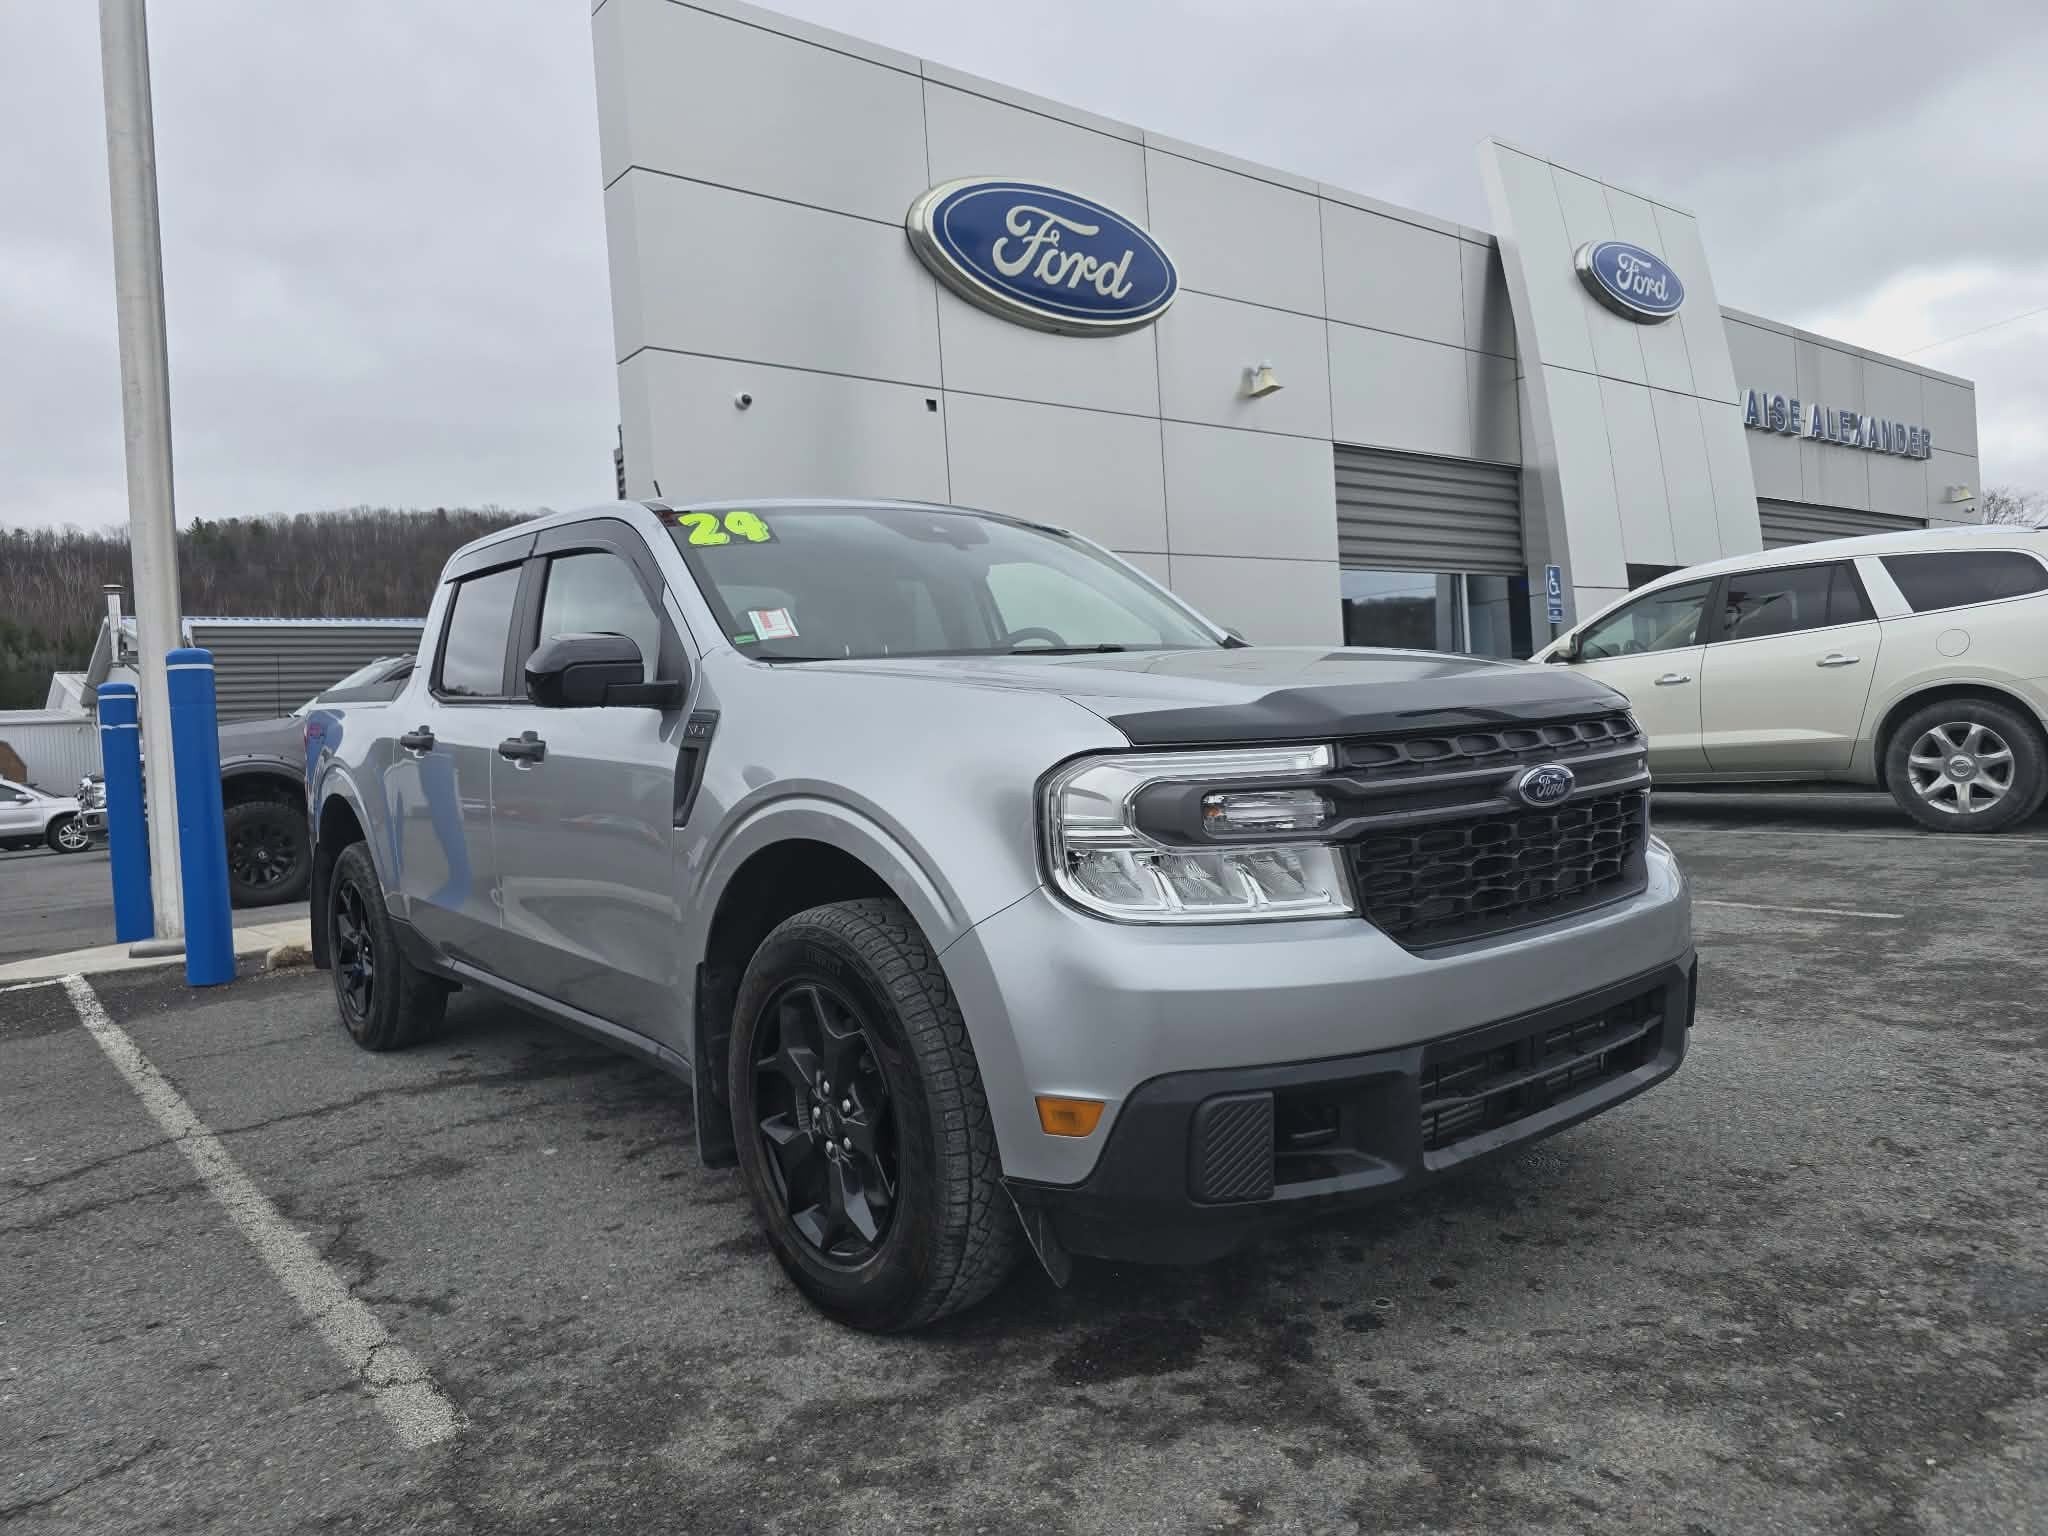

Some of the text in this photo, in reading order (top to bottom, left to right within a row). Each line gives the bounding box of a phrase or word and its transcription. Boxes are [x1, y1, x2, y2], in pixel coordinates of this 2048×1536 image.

[992, 205, 1134, 299] Ford
[1616, 253, 1669, 301] Ford
[1744, 389, 1933, 459] AISE ALEXANDER
[1536, 774, 1566, 798] Ford
